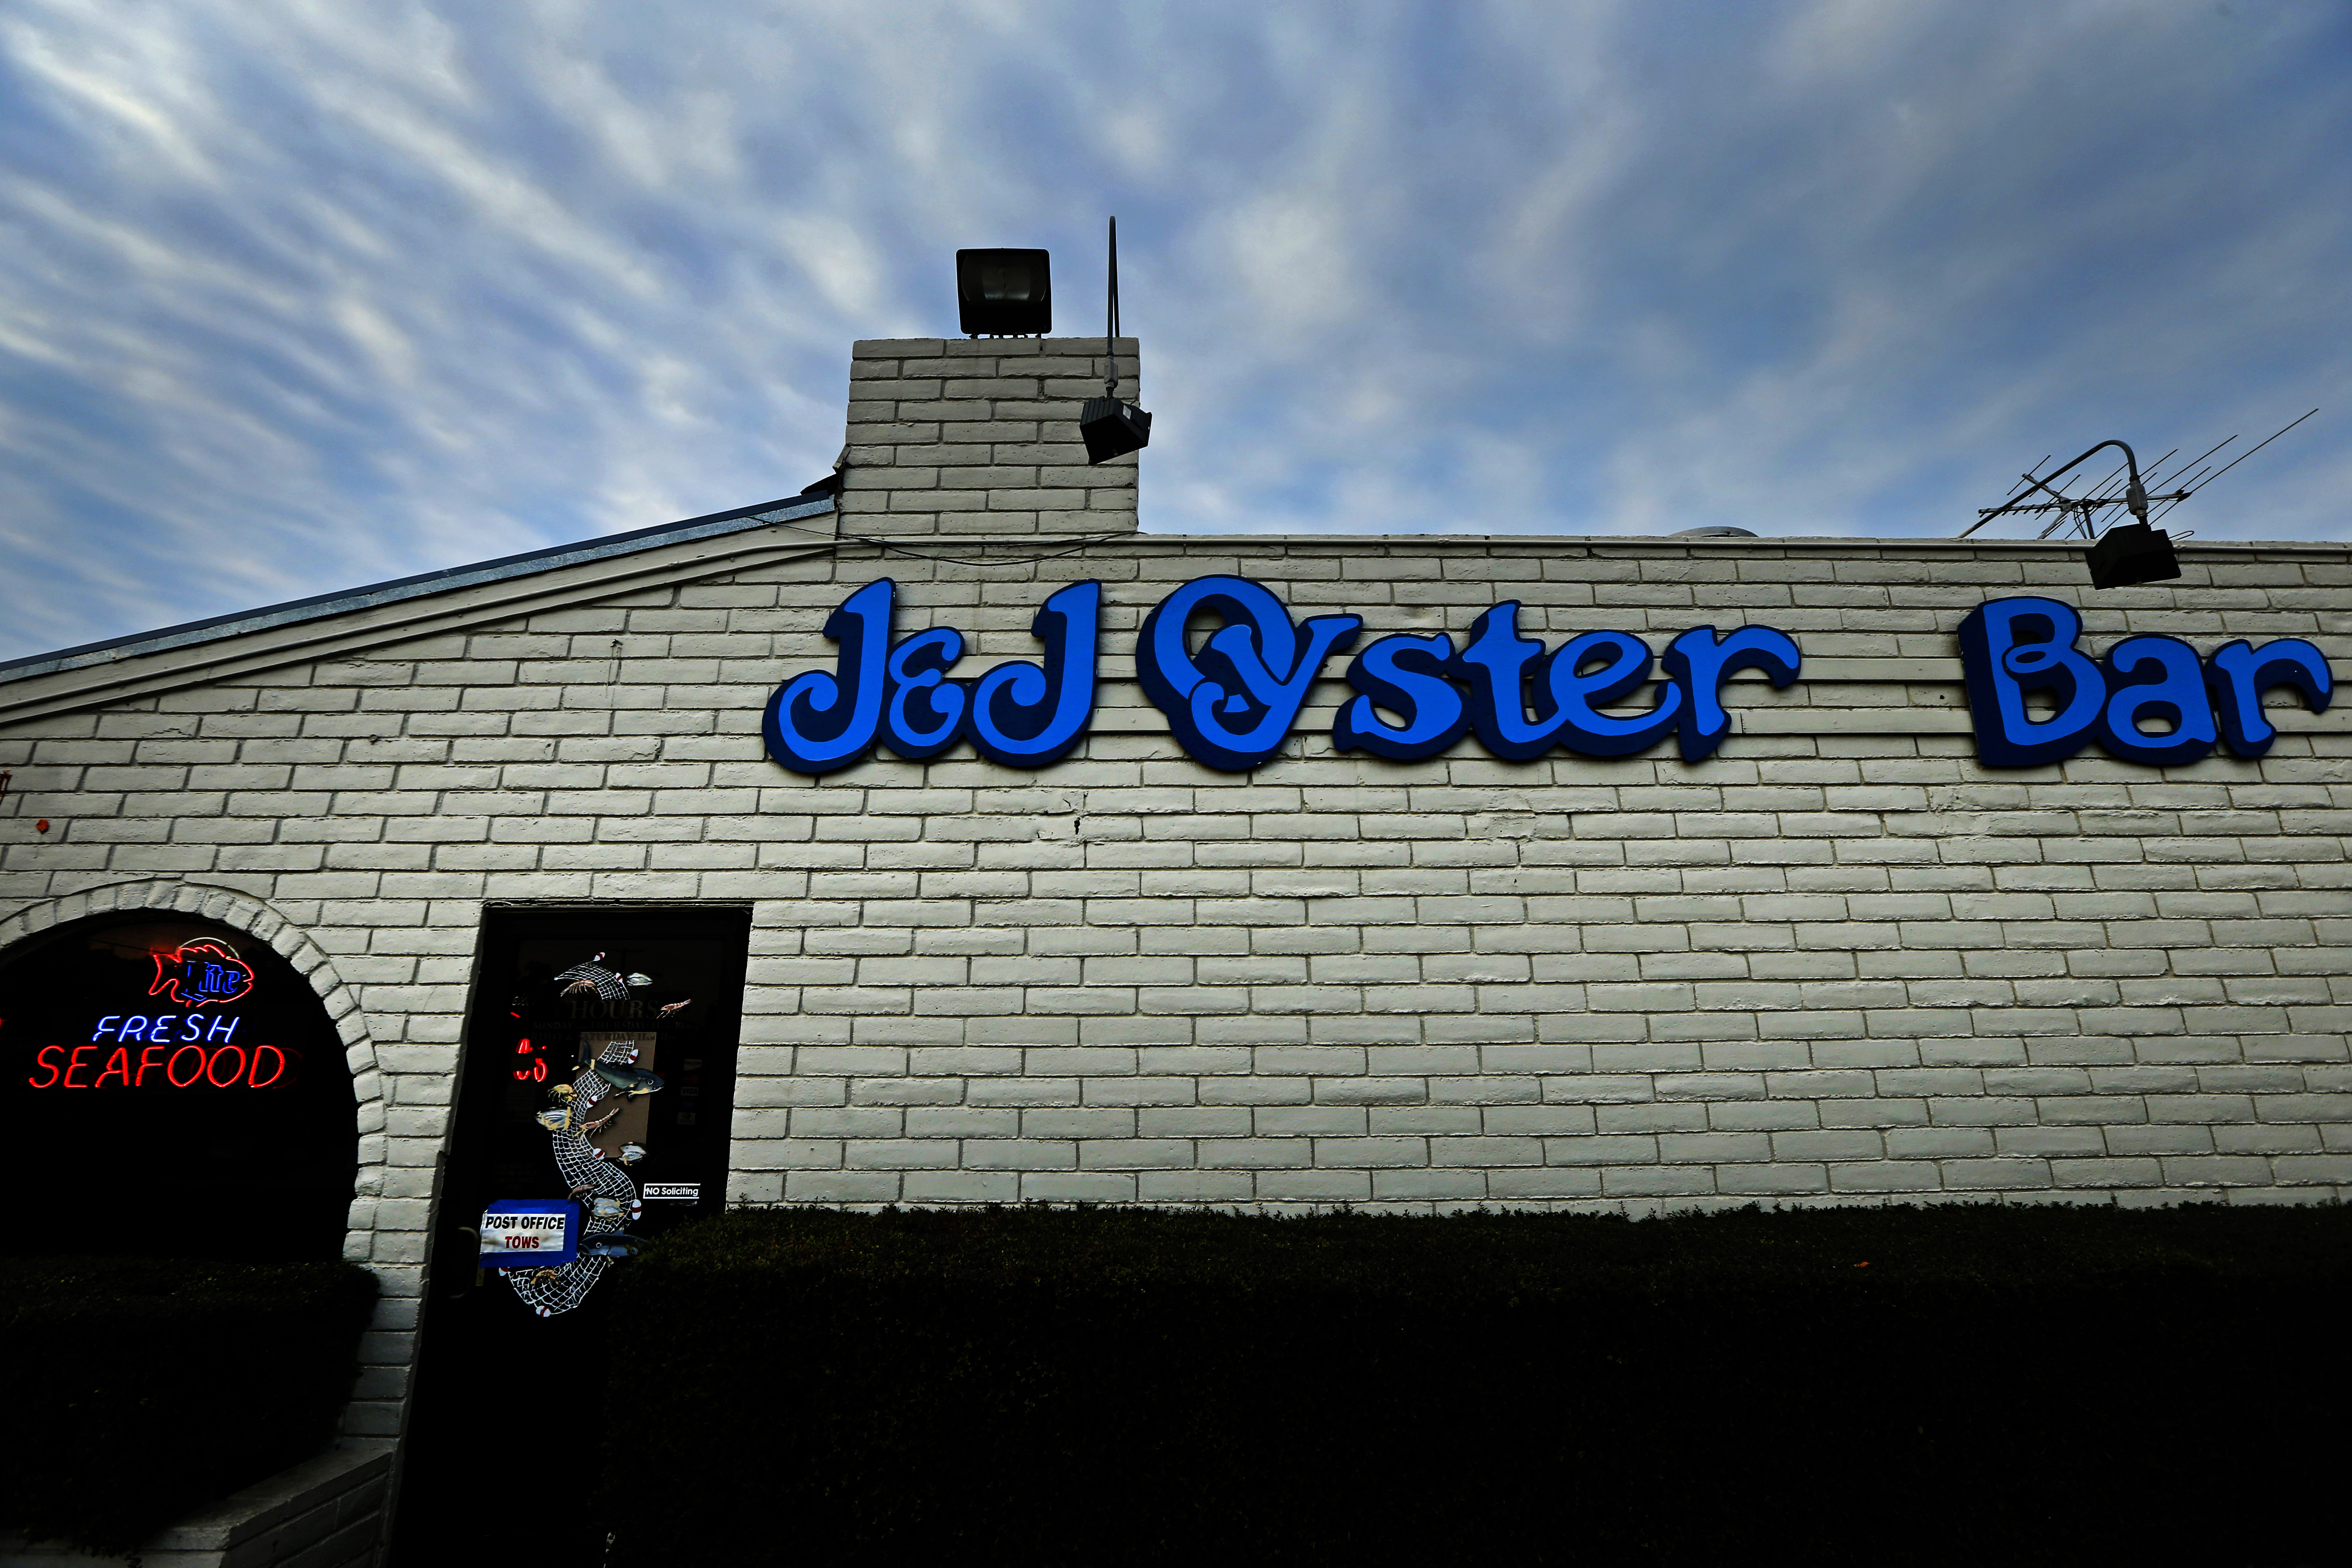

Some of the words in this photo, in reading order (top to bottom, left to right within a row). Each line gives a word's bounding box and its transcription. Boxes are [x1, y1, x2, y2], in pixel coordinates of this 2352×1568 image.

[762, 577, 1102, 772] J&J
[1135, 574, 1801, 772] Oyster
[1957, 596, 2333, 765] Bar
[569, 1000, 657, 1019] HOURS
[93, 1014, 239, 1043] FRESH
[532, 1021, 573, 1029] SUNDAY
[29, 1045, 284, 1088] SEAFOOD
[662, 1187, 698, 1196] Soliciting
[485, 1216, 518, 1229] POST
[521, 1216, 565, 1230] OFFICE
[505, 1236, 539, 1249] TOWS
